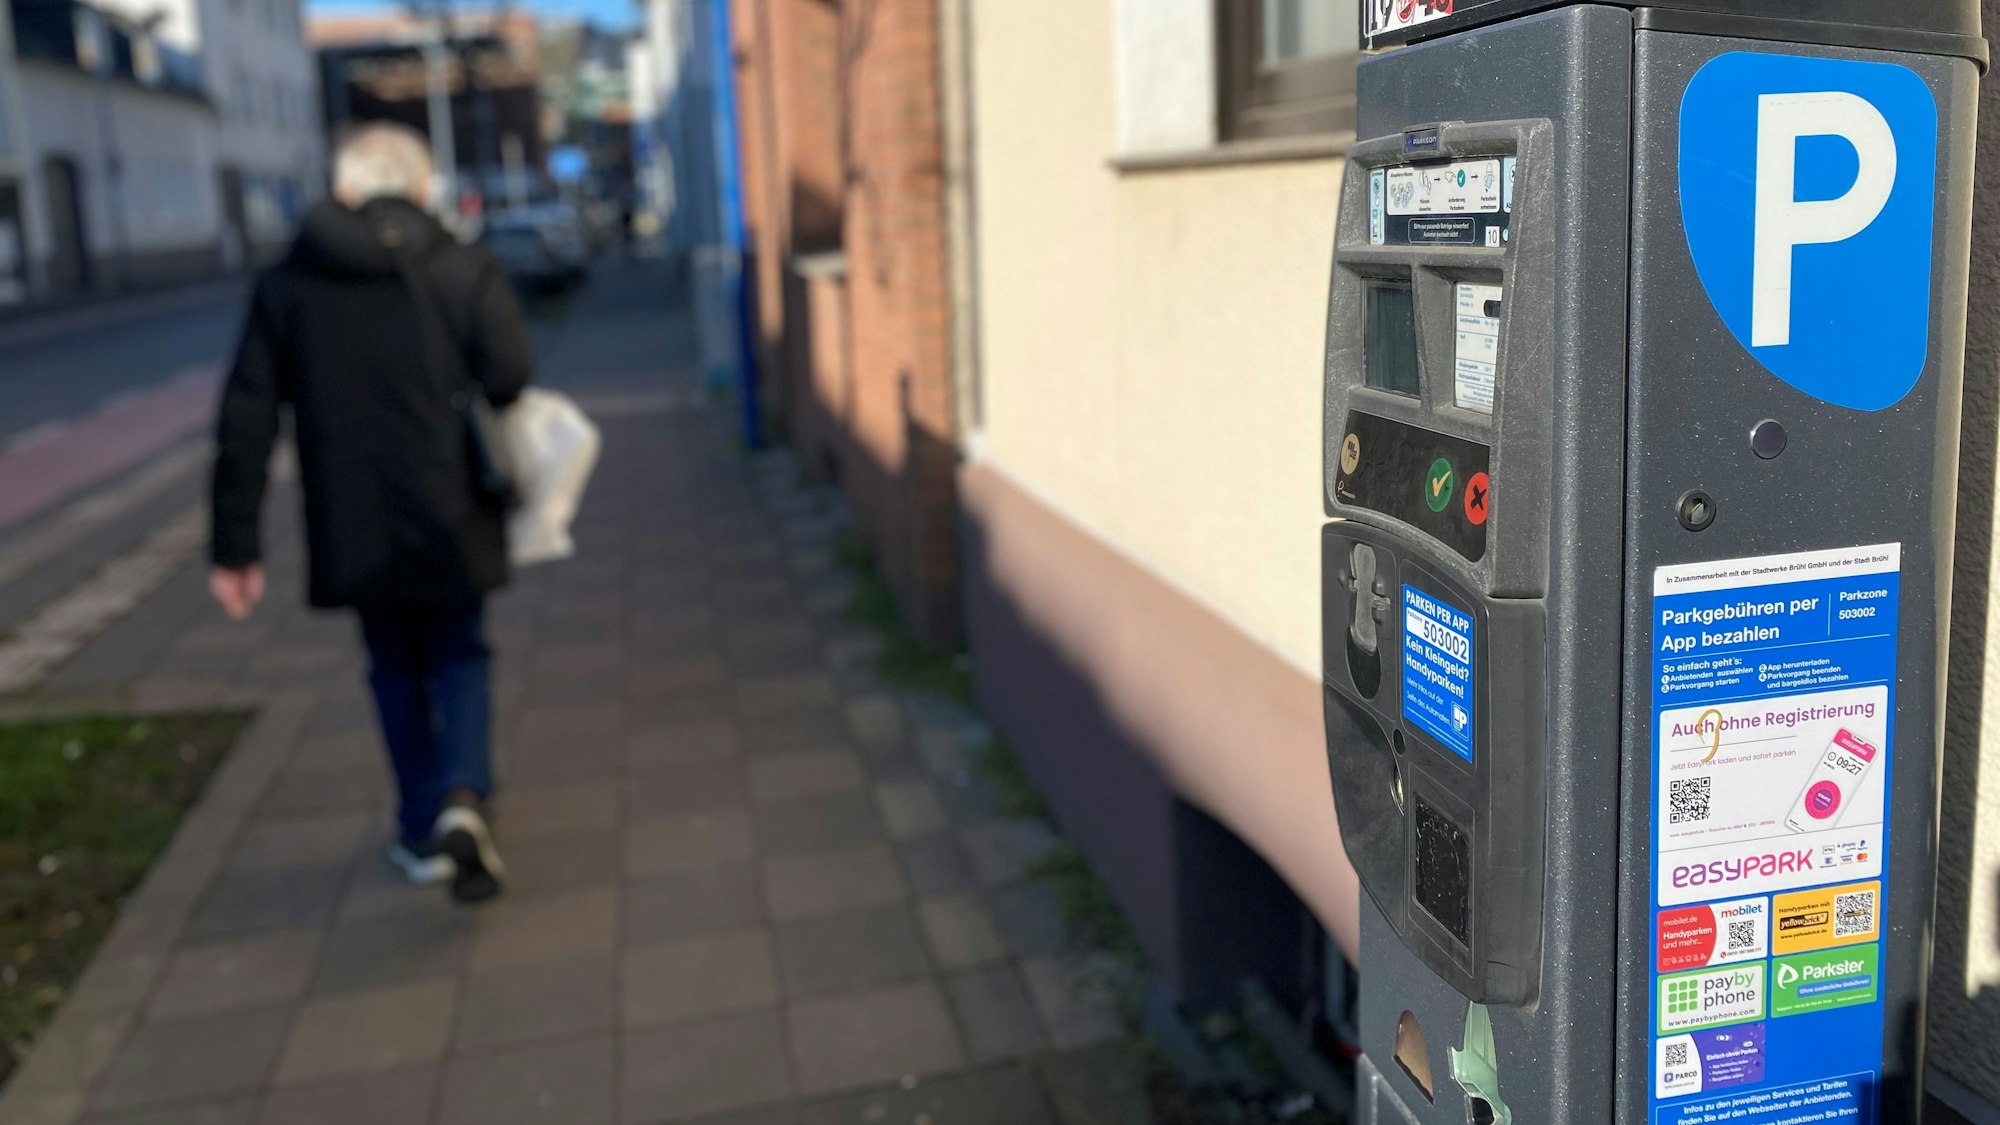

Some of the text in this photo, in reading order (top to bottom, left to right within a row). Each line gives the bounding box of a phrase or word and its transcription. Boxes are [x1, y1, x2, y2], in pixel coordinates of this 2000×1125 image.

[1752, 92, 1897, 346] P
[1488, 229, 1497, 243] 10
[1674, 572, 1728, 583] Zusammenarbeit
[1752, 565, 1787, 575] Stadtwerke
[1789, 563, 1806, 571] Brühl
[1807, 561, 1827, 569] GmbH
[1872, 555, 1889, 563] Brühl
[1839, 588, 1888, 602] Parkzone
[1406, 589, 1470, 634] PARKEN PER APP
[1662, 596, 1819, 626] Parkgebühren per
[1838, 606, 1876, 620] 503002
[1423, 619, 1468, 661] 503002
[1661, 625, 1780, 653] App bezahlen
[1406, 634, 1470, 683] Kein Kleingeld?
[1662, 664, 1675, 674] So
[1677, 660, 1710, 672] einfach
[1767, 664, 1782, 672] App
[1783, 658, 1830, 669] herunterladen
[1406, 652, 1464, 699] Handyparken!
[1670, 672, 1714, 682] Anbietenden
[1716, 667, 1753, 677] auswählen
[1767, 669, 1810, 680] Parkvorgang
[1811, 665, 1842, 675] beenden
[1767, 674, 1849, 689] und bargeldlos bezahlen
[1406, 676, 1418, 688] Mehr
[1417, 681, 1428, 695] Infos
[1670, 681, 1714, 691] Parkvorgang
[1715, 677, 1740, 686] starten
[1672, 702, 1875, 737] Auch ohne Registrierung
[1670, 762, 1686, 770] Jetzt
[1717, 757, 1737, 765] laden
[1738, 754, 1752, 763] und
[1752, 753, 1772, 761] sofort
[1773, 749, 1796, 760] parken
[1836, 756, 1862, 776] 09:27
[1721, 904, 1762, 918] mobilet
[1663, 915, 1698, 927] mobilet.de
[1663, 926, 1713, 940] Handyparken
[1663, 940, 1677, 949] und
[1802, 959, 1865, 981] Parkster
[1704, 989, 1756, 1011] phone
[1668, 1008, 1755, 1027] www.paybyphone.com
[1675, 1070, 1698, 1080] PARCO
[1683, 1080, 1848, 1115] Infos zu den jeweiligen Services und Tarifen
[1677, 1091, 1853, 1125] finden Sie auf den Webseiten der Anbietenden.
[1776, 1107, 1859, 1125] kontaktieren Sie Ihren
